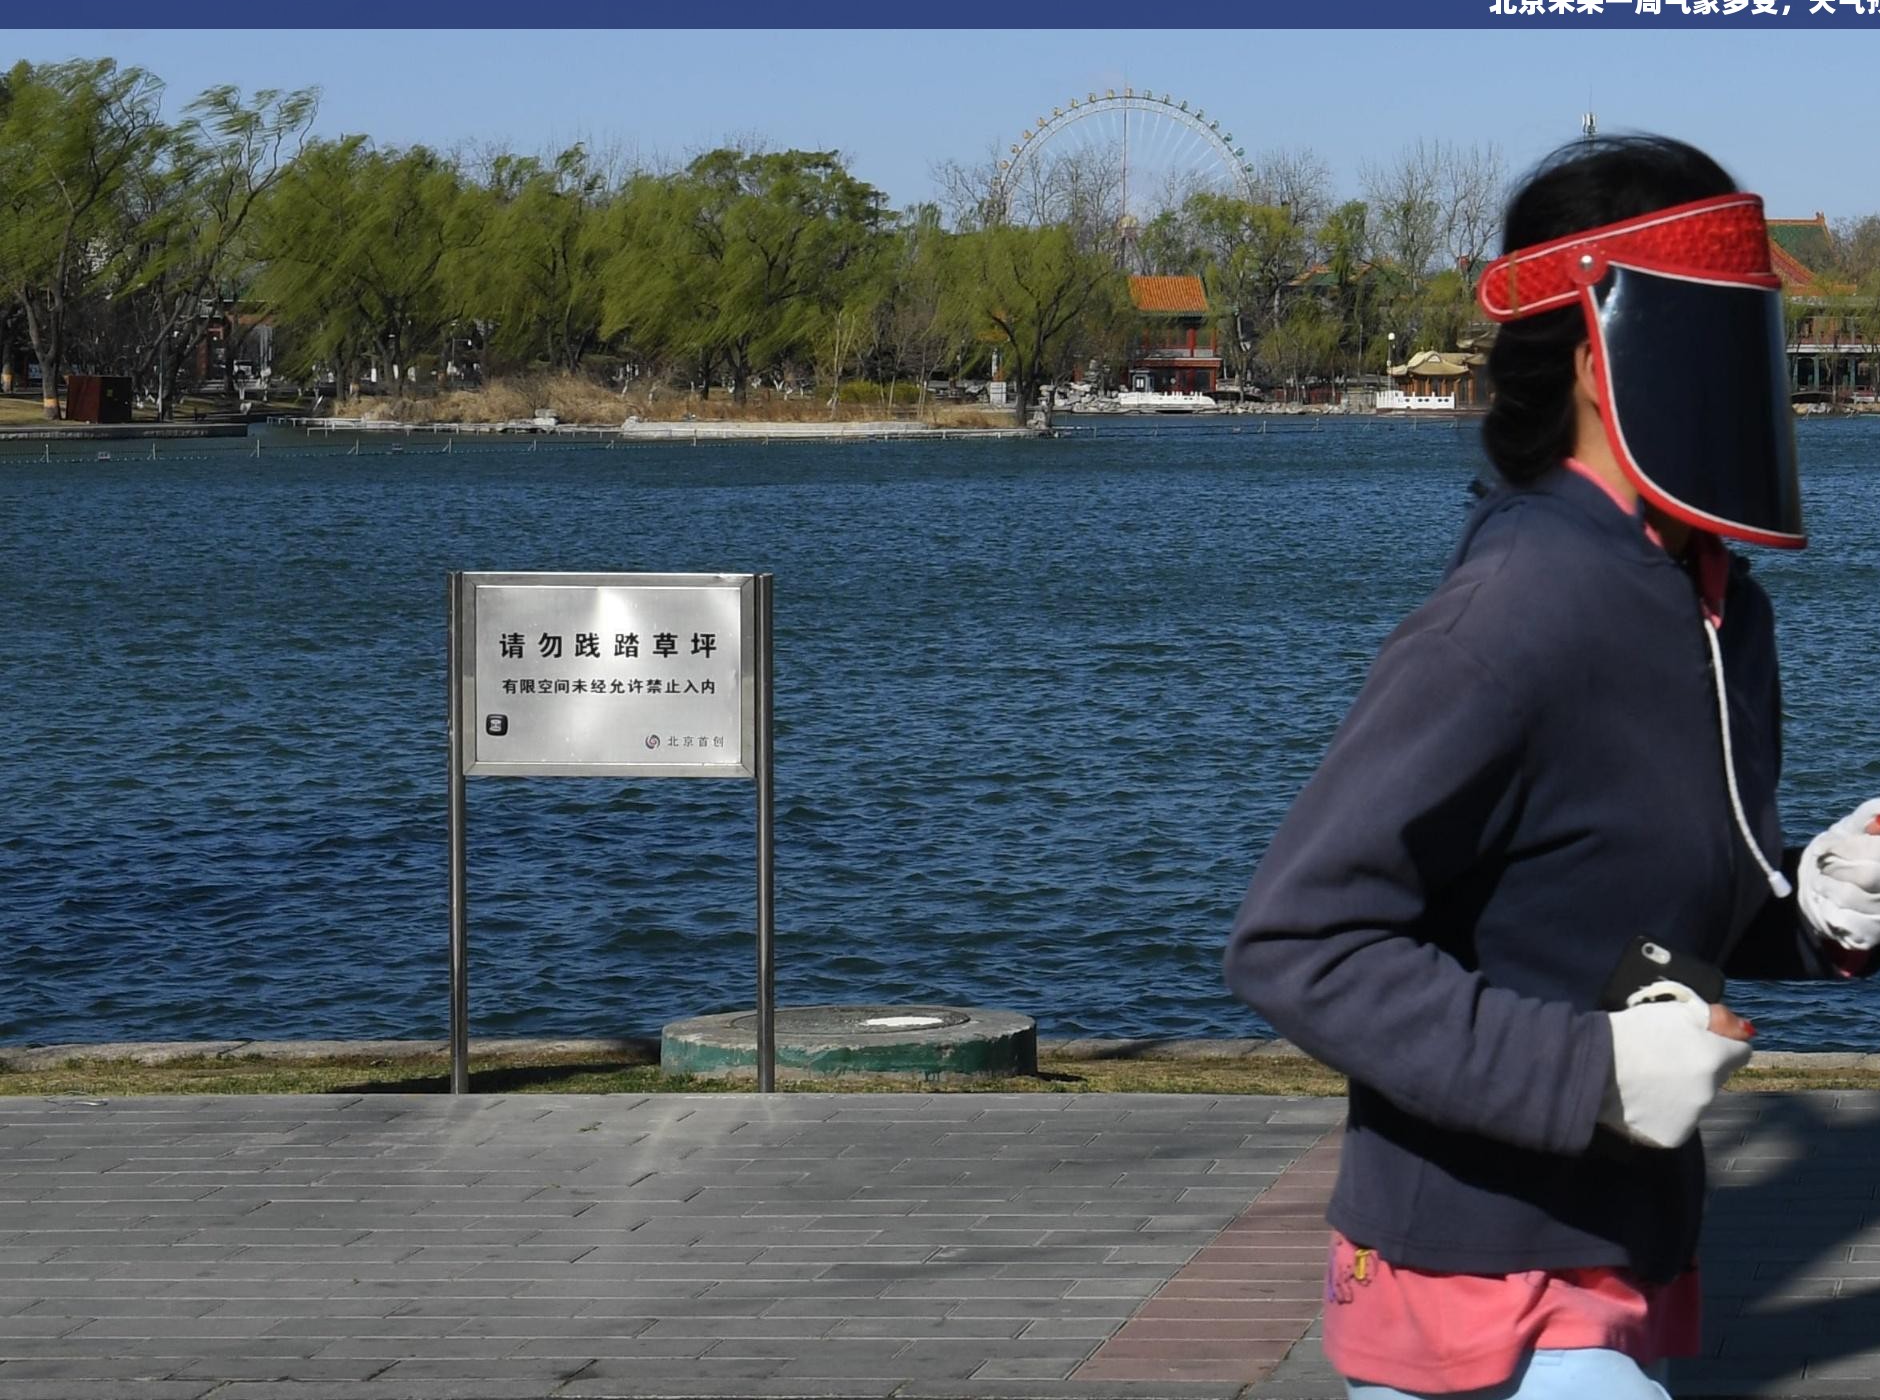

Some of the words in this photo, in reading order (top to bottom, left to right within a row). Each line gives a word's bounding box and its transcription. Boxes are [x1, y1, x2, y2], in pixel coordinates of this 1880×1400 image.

[499, 632, 717, 659] 请勿践踏草坪
[502, 678, 715, 694] 有限空间未经允许禁止入内
